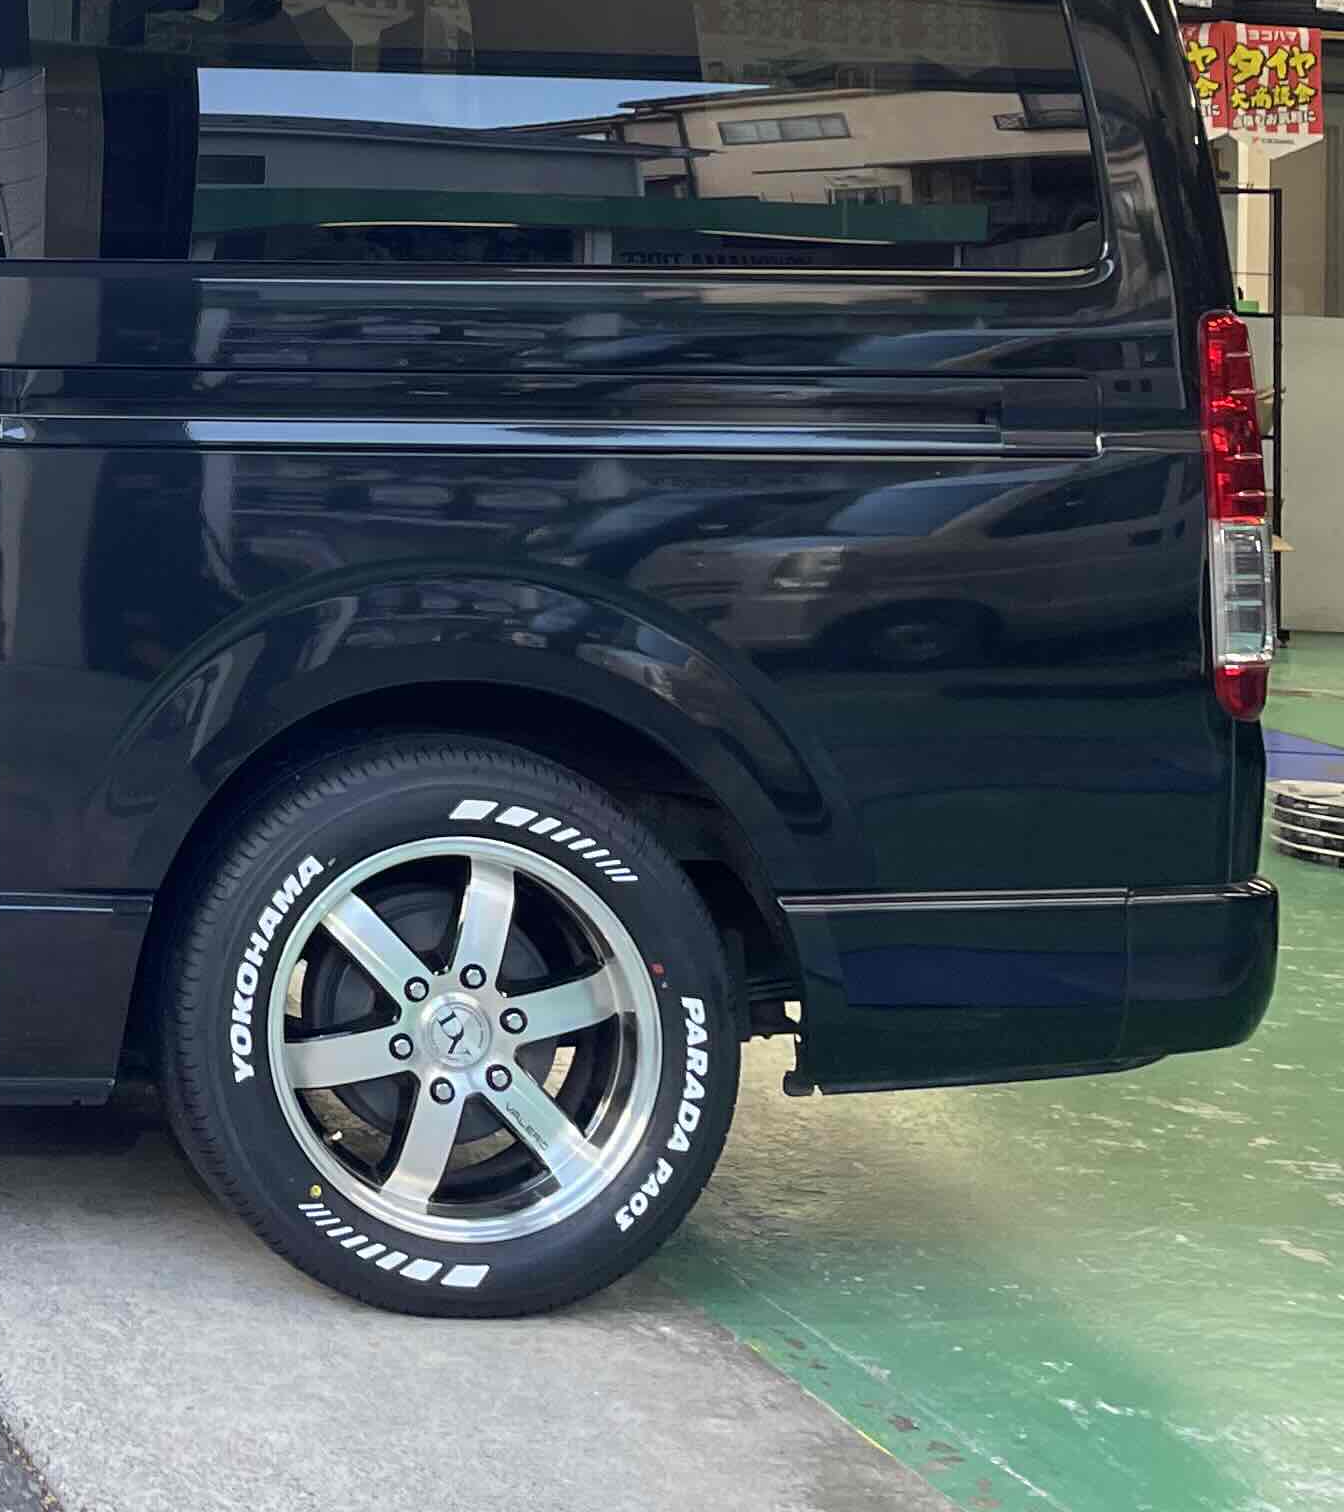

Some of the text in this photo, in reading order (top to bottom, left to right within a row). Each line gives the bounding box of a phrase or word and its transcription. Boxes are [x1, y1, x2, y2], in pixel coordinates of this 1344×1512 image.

[1228, 43, 1316, 84] タイヤ
[229, 856, 324, 1082] YOKOHAMA
[615, 996, 709, 1231] PARADA PA03
